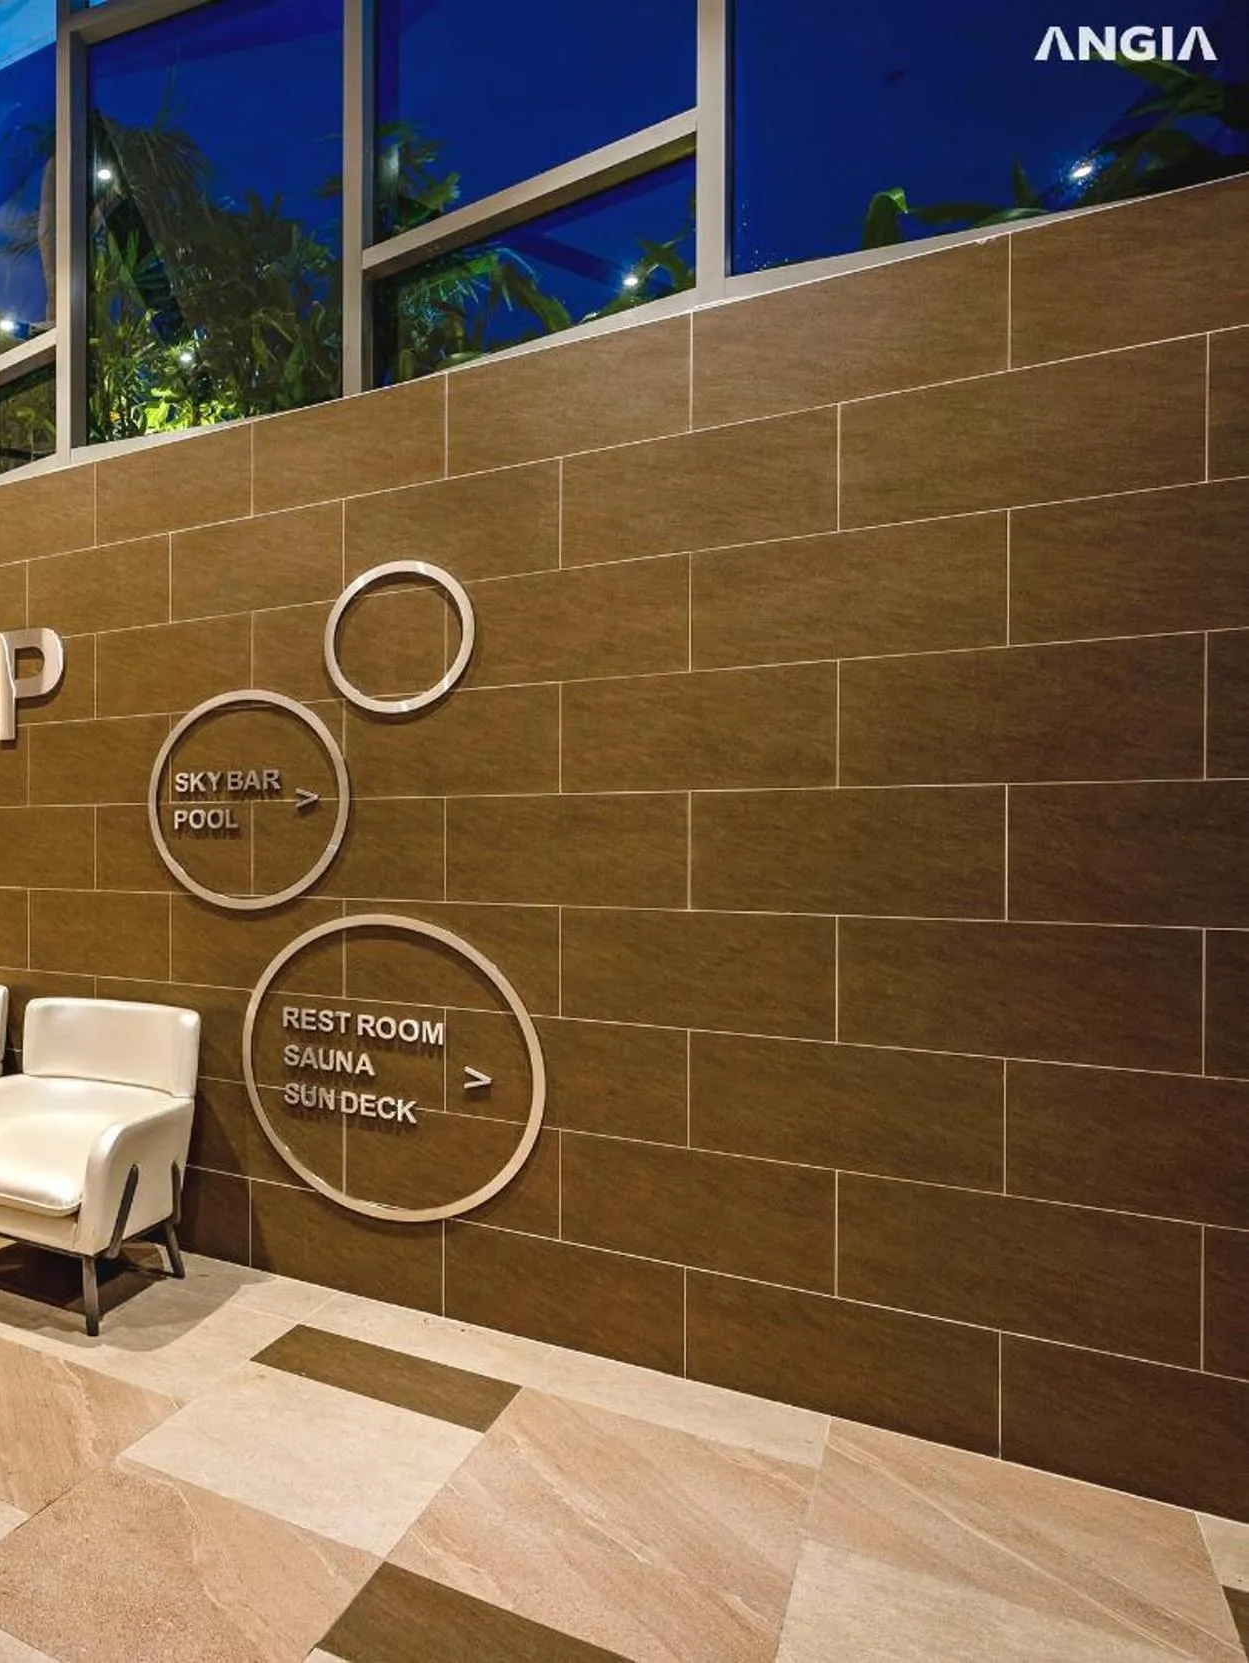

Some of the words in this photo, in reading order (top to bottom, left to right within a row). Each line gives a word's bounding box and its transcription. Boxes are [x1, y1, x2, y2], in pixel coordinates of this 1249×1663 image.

[175, 771, 222, 793] SKY
[227, 769, 280, 791] BAR
[174, 809, 238, 830] POOL
[282, 1006, 351, 1034] REST
[357, 1014, 444, 1046] ROOM
[283, 1044, 376, 1077] SAUNA
[283, 1083, 336, 1111] SUN
[341, 1091, 417, 1124] DECK
